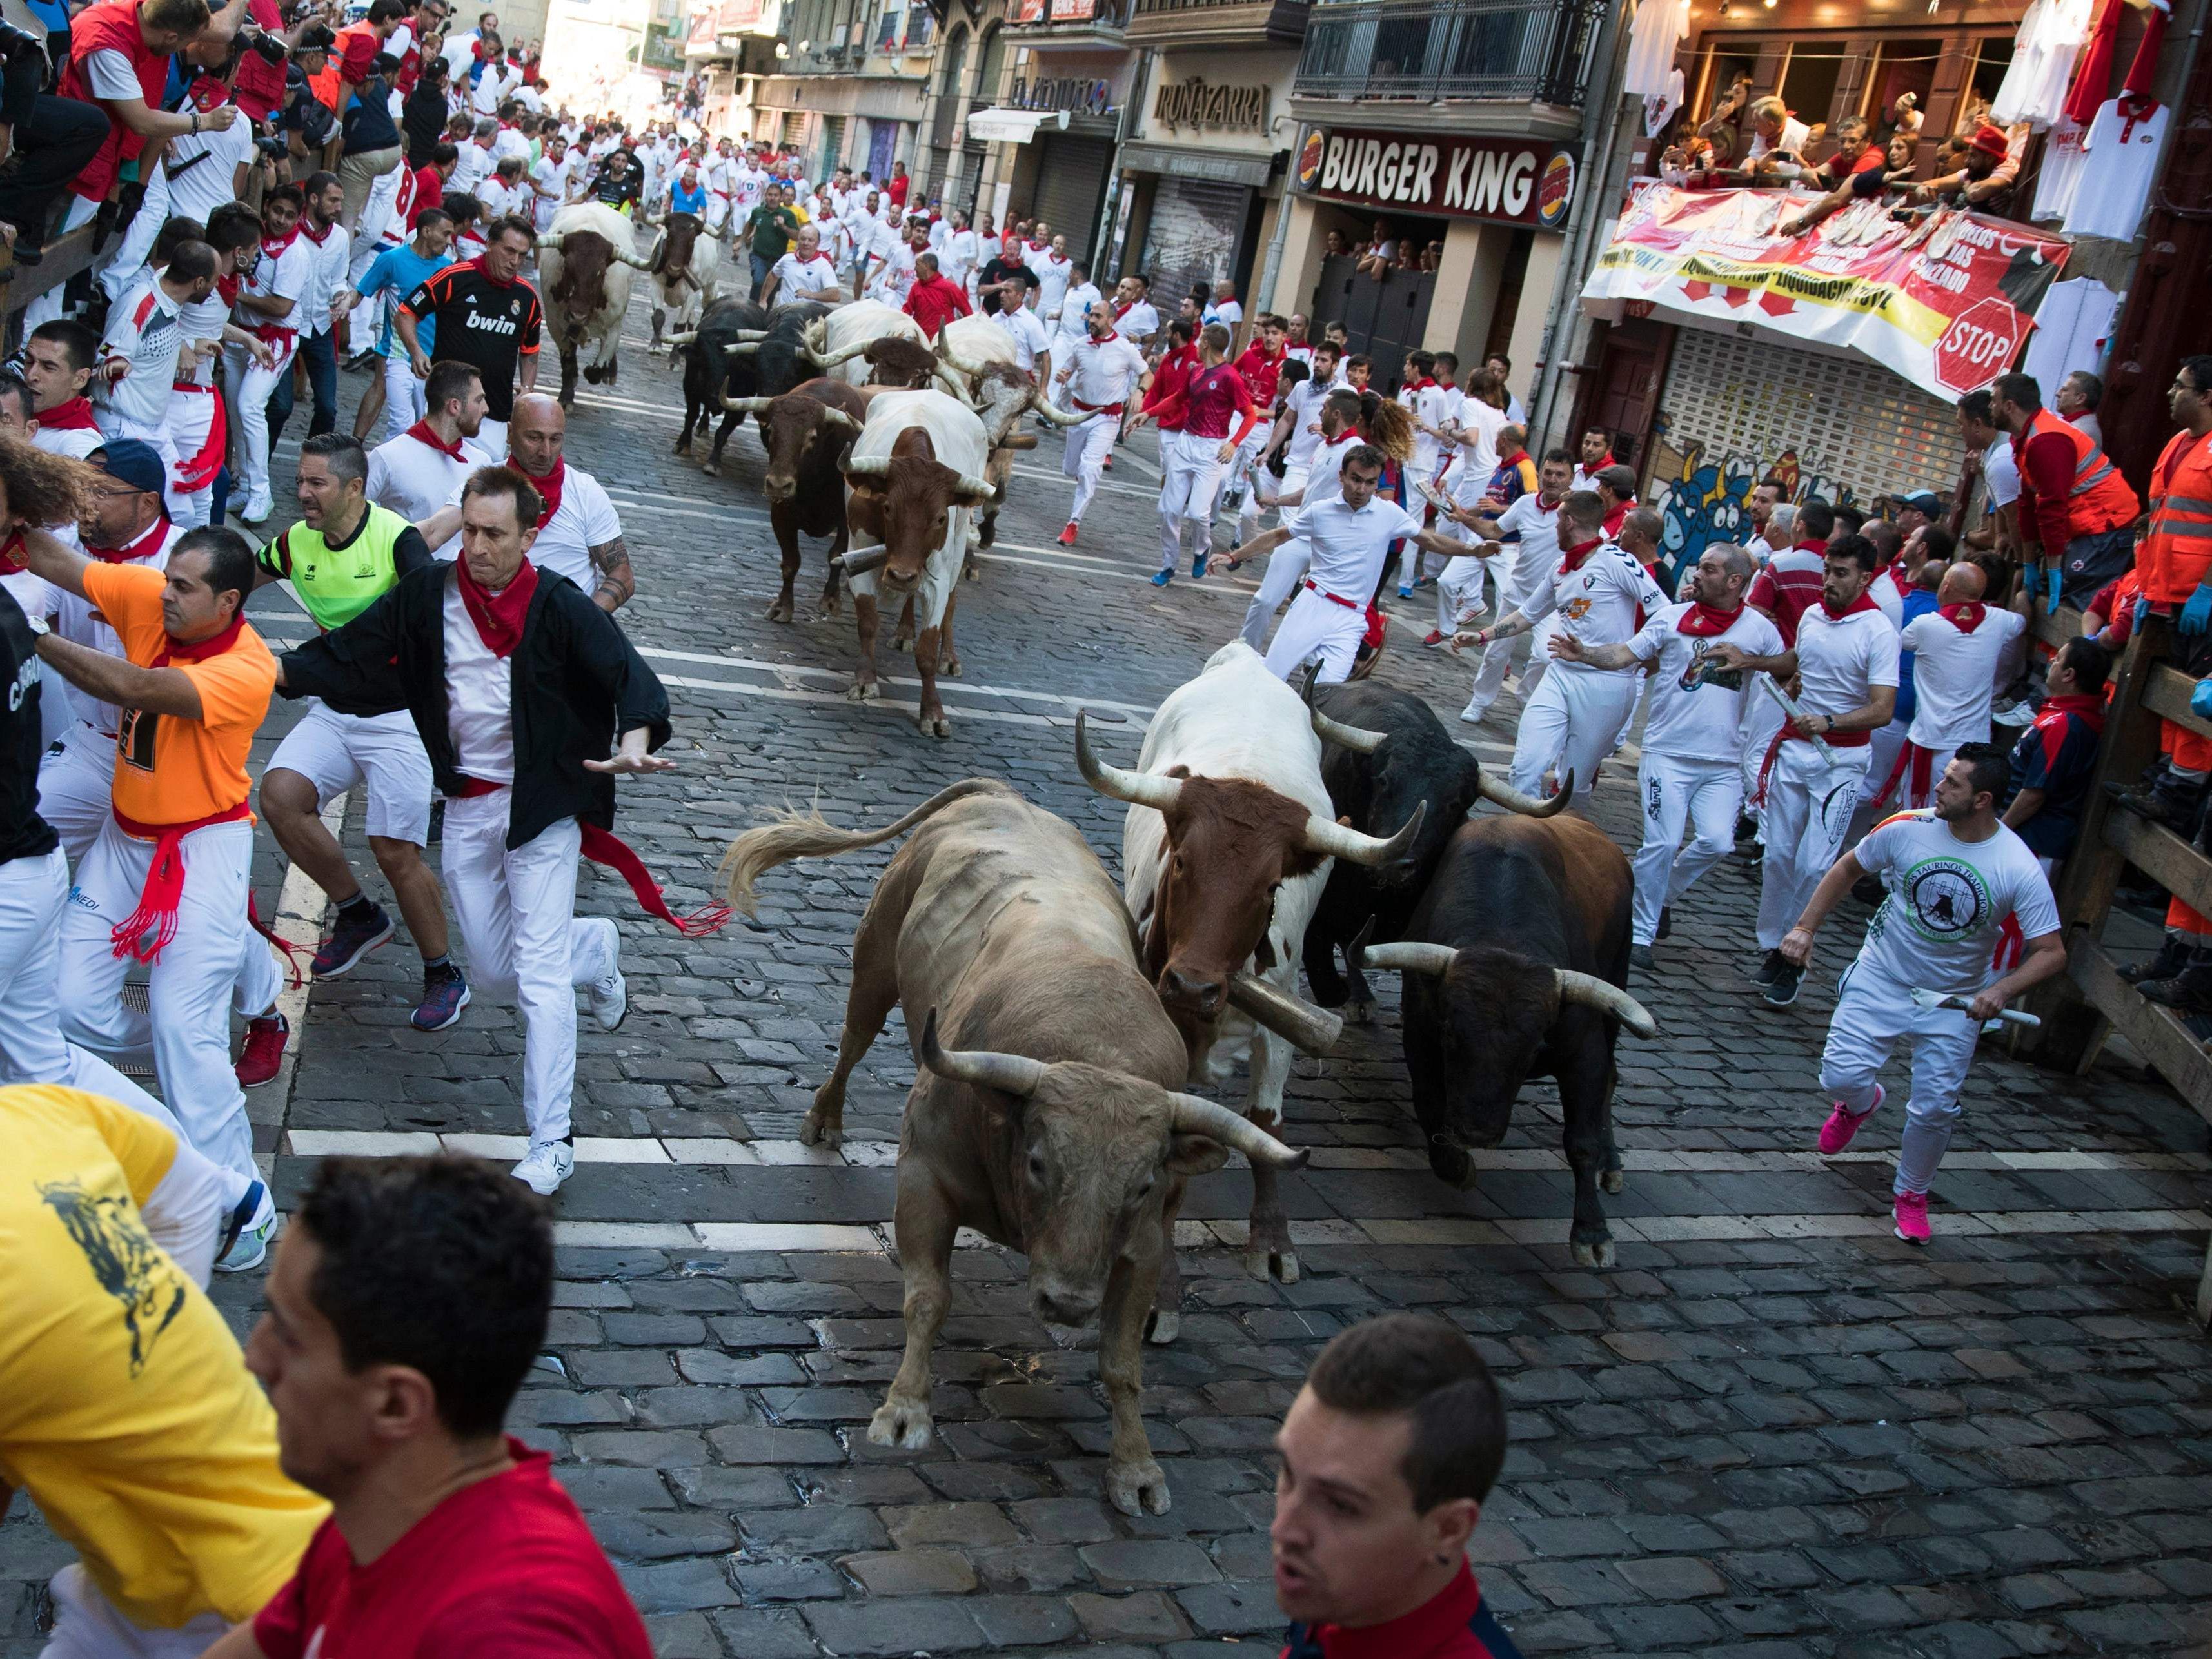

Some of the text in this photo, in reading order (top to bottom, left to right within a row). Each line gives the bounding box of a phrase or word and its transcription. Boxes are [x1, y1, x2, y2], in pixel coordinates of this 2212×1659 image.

[1321, 136, 1537, 217] BURGER KING
[466, 309, 517, 335] bwin
[1944, 322, 2010, 368] STOP
[1917, 861, 1963, 876] TAURINOS
